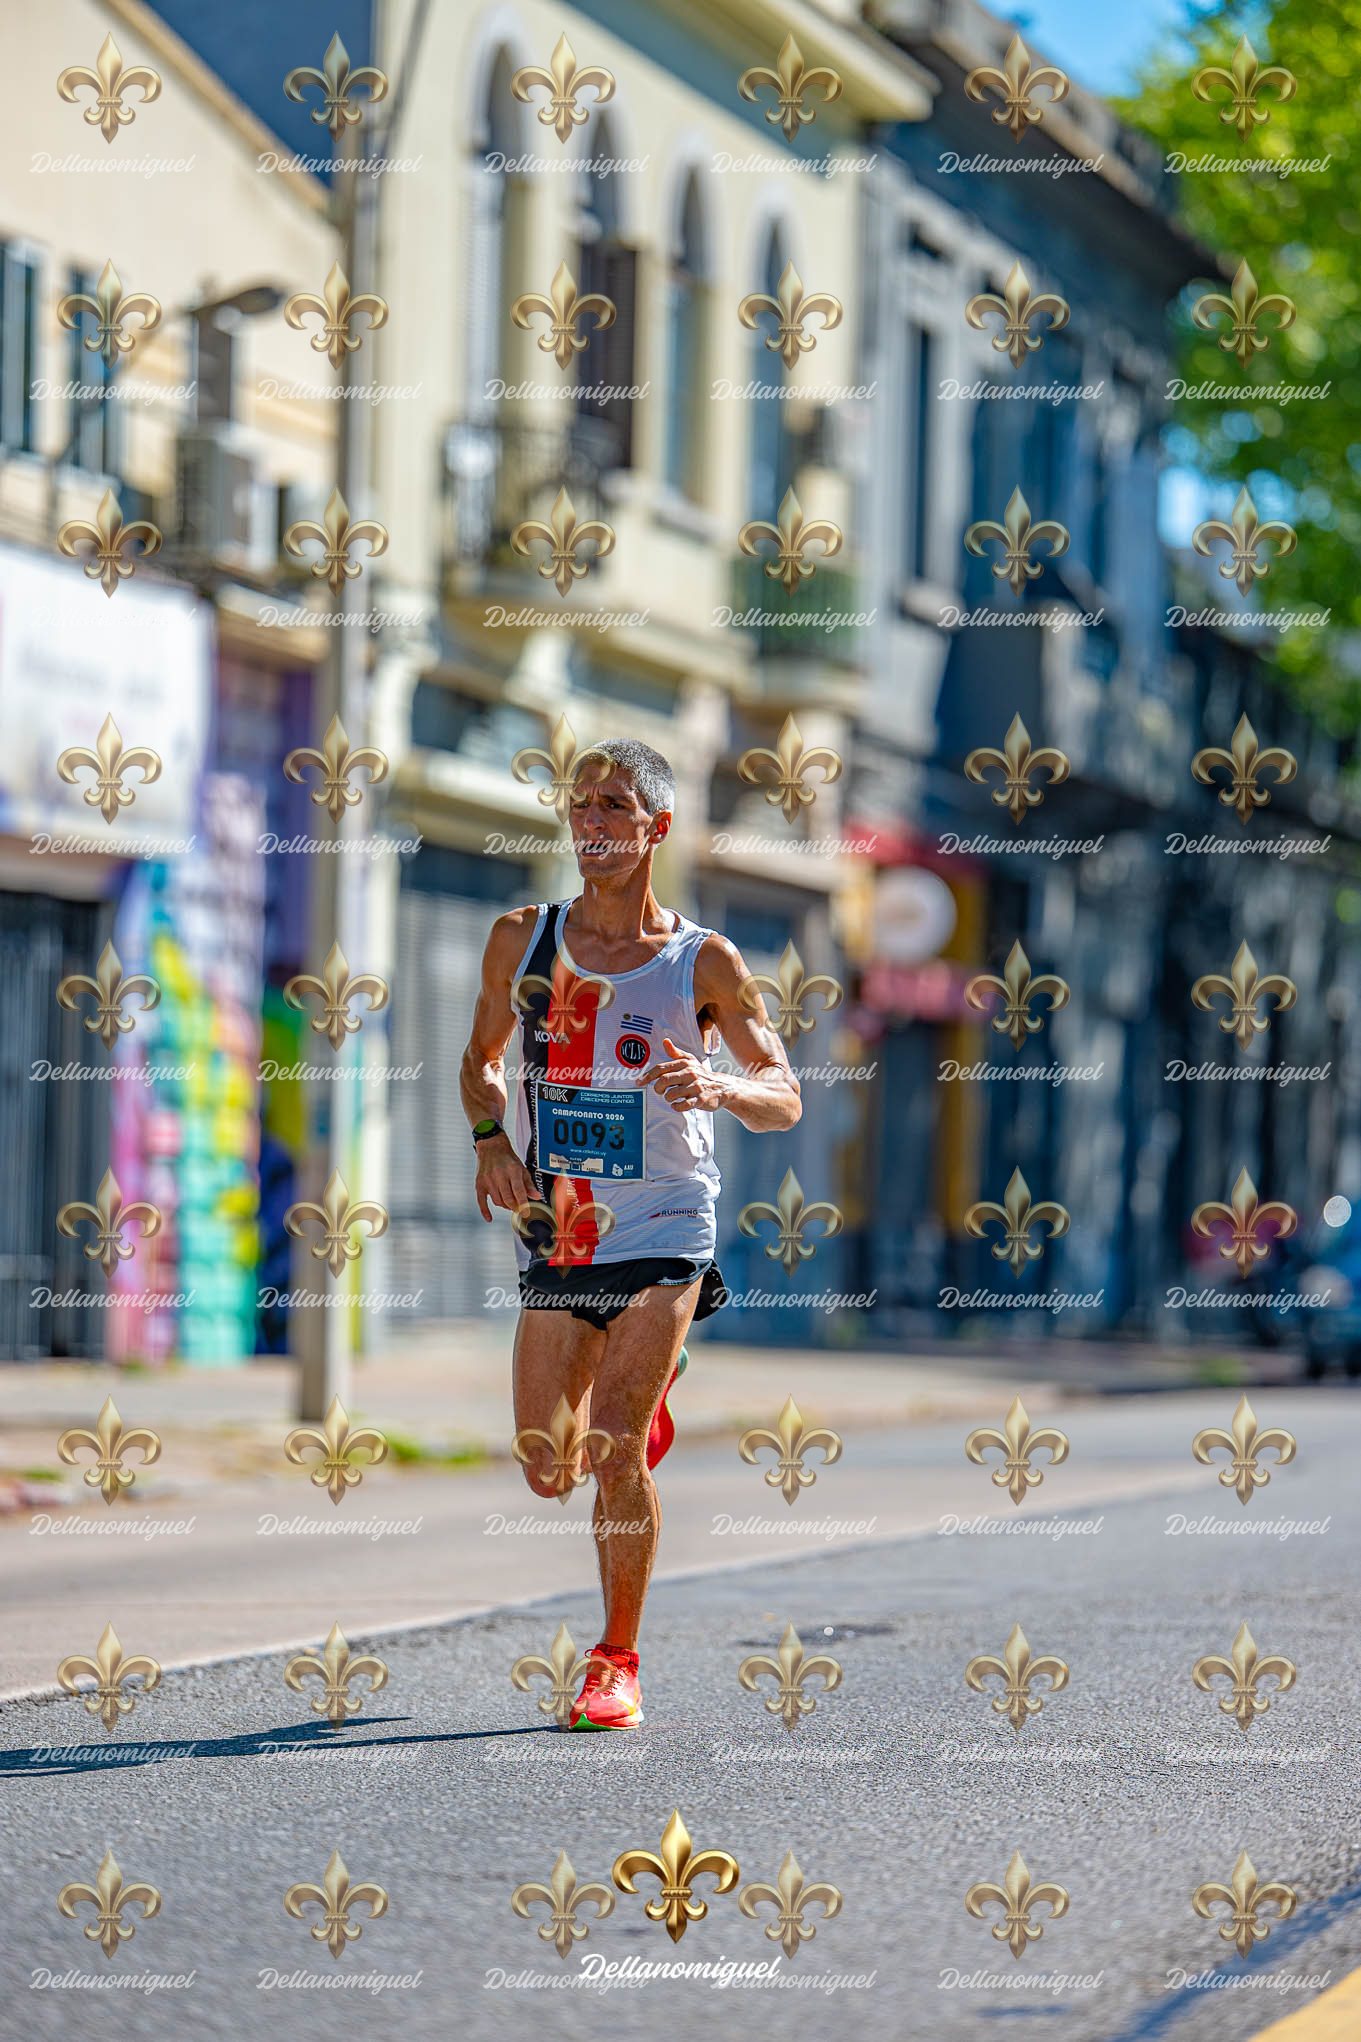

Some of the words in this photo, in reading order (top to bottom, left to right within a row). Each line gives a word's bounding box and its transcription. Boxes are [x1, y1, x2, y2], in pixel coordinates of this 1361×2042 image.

[534, 1030, 570, 1044] KOVA
[542, 1086, 568, 1103] 10K
[552, 1108, 604, 1119] CAMPEONATO
[605, 1112, 625, 1121] 2026
[553, 1119, 625, 1150] 0093
